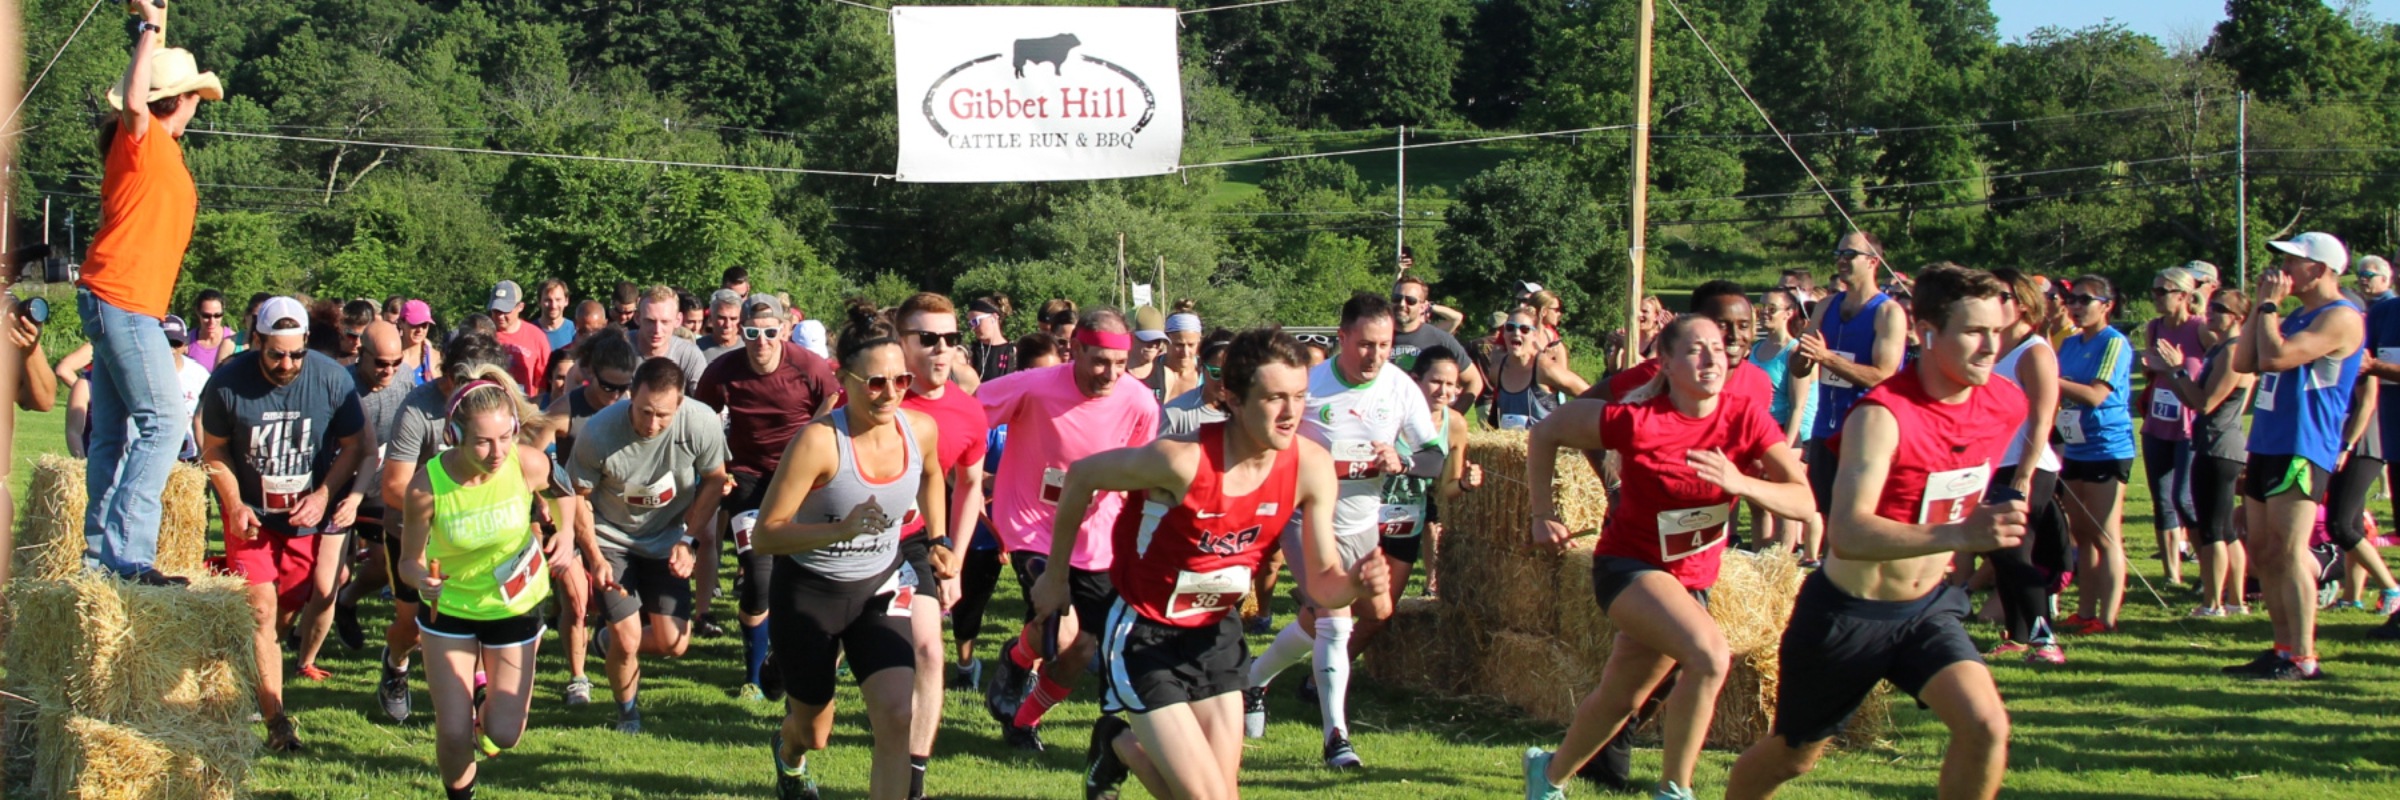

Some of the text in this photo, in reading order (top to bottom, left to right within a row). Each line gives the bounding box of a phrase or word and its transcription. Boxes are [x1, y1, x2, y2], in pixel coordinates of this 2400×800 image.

[949, 87, 1127, 120] Gibbet Hill
[948, 131, 1134, 149] CATTLE RUN & BBQ
[249, 418, 315, 458] KILL
[2063, 425, 2073, 440] 22
[1348, 461, 1369, 479] 62
[1949, 496, 1966, 520] 5
[1384, 523, 1403, 536] 57
[1198, 525, 1262, 558] USA
[1691, 530, 1704, 548] 4
[523, 566, 532, 584] 2
[1191, 593, 1222, 608] 36
